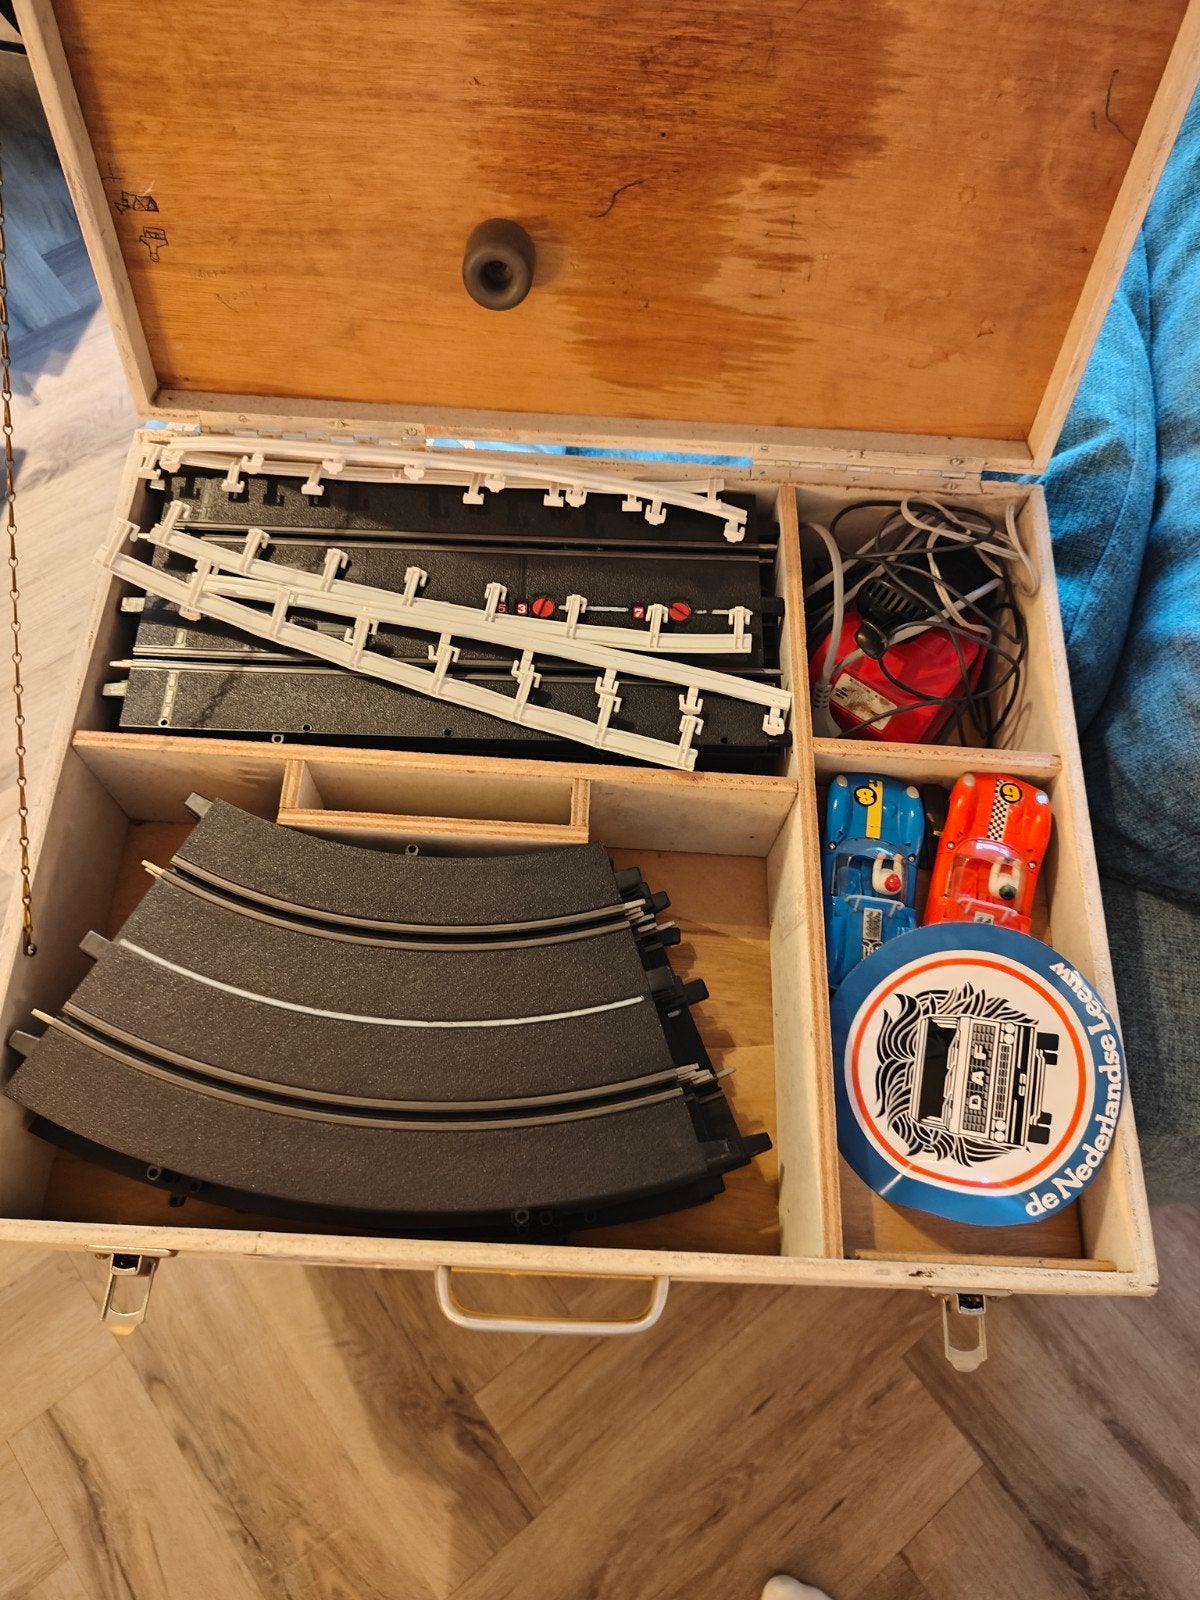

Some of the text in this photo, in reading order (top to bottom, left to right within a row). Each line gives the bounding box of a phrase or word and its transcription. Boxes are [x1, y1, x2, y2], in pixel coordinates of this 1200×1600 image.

[517, 603, 527, 614] 3
[634, 607, 644, 618] 7
[855, 787, 875, 805] 8
[968, 1044, 987, 1111] DAF
[1025, 962, 1122, 1217] de Nederlandse Leeuw
